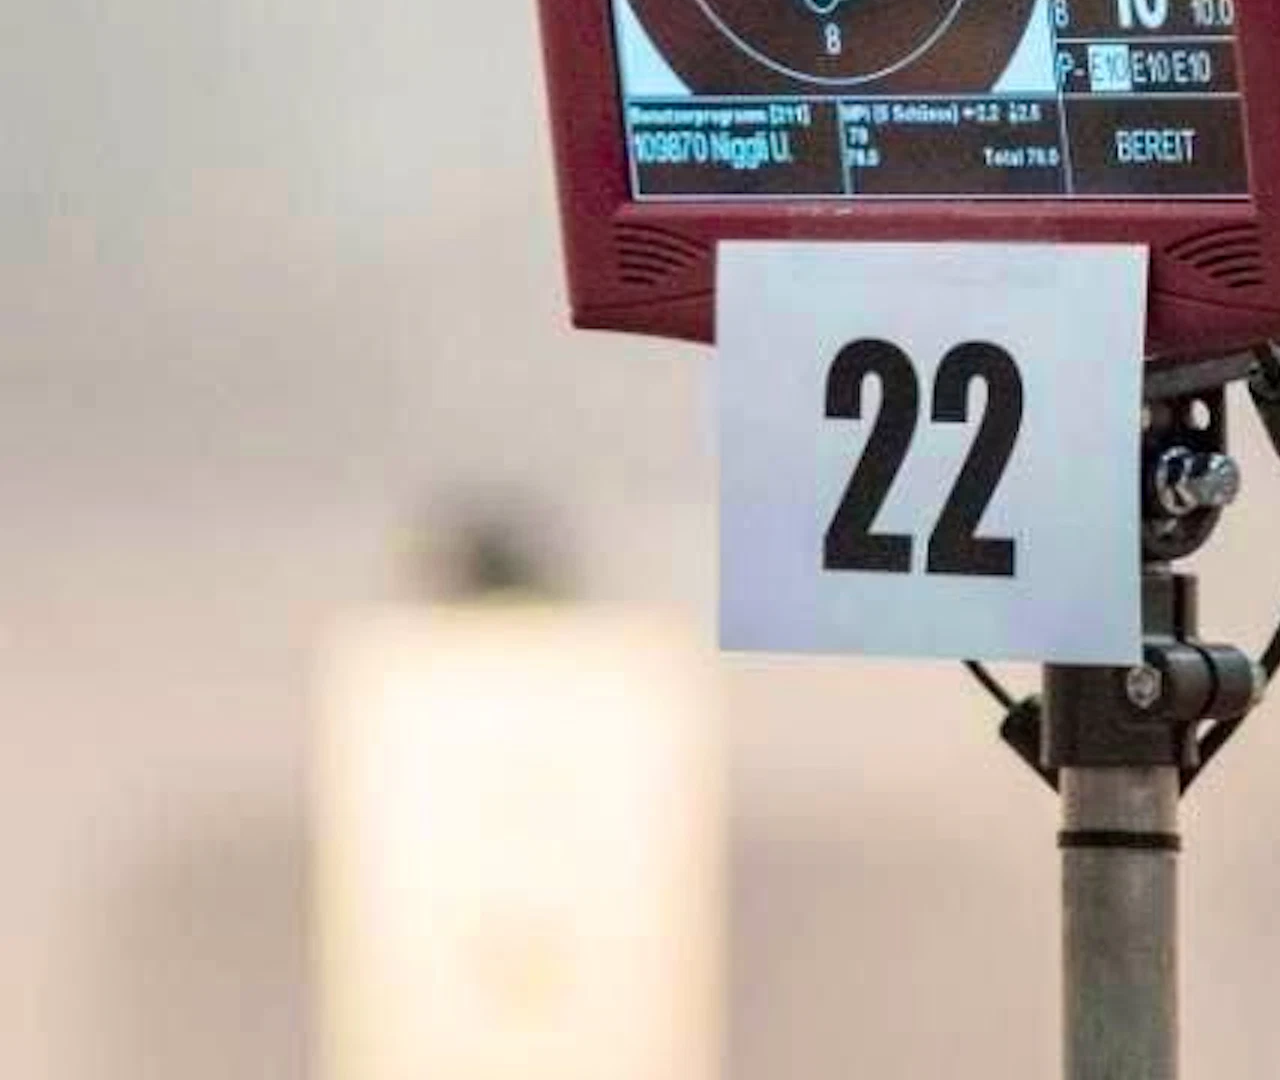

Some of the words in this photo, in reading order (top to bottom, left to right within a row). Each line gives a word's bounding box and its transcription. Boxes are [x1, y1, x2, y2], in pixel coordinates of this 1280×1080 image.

[824, 24, 841, 55] 8
[1132, 50, 1169, 83] E10
[1172, 51, 1211, 83] E10
[1115, 130, 1196, 163] BEREIT
[823, 337, 1024, 577] 22
